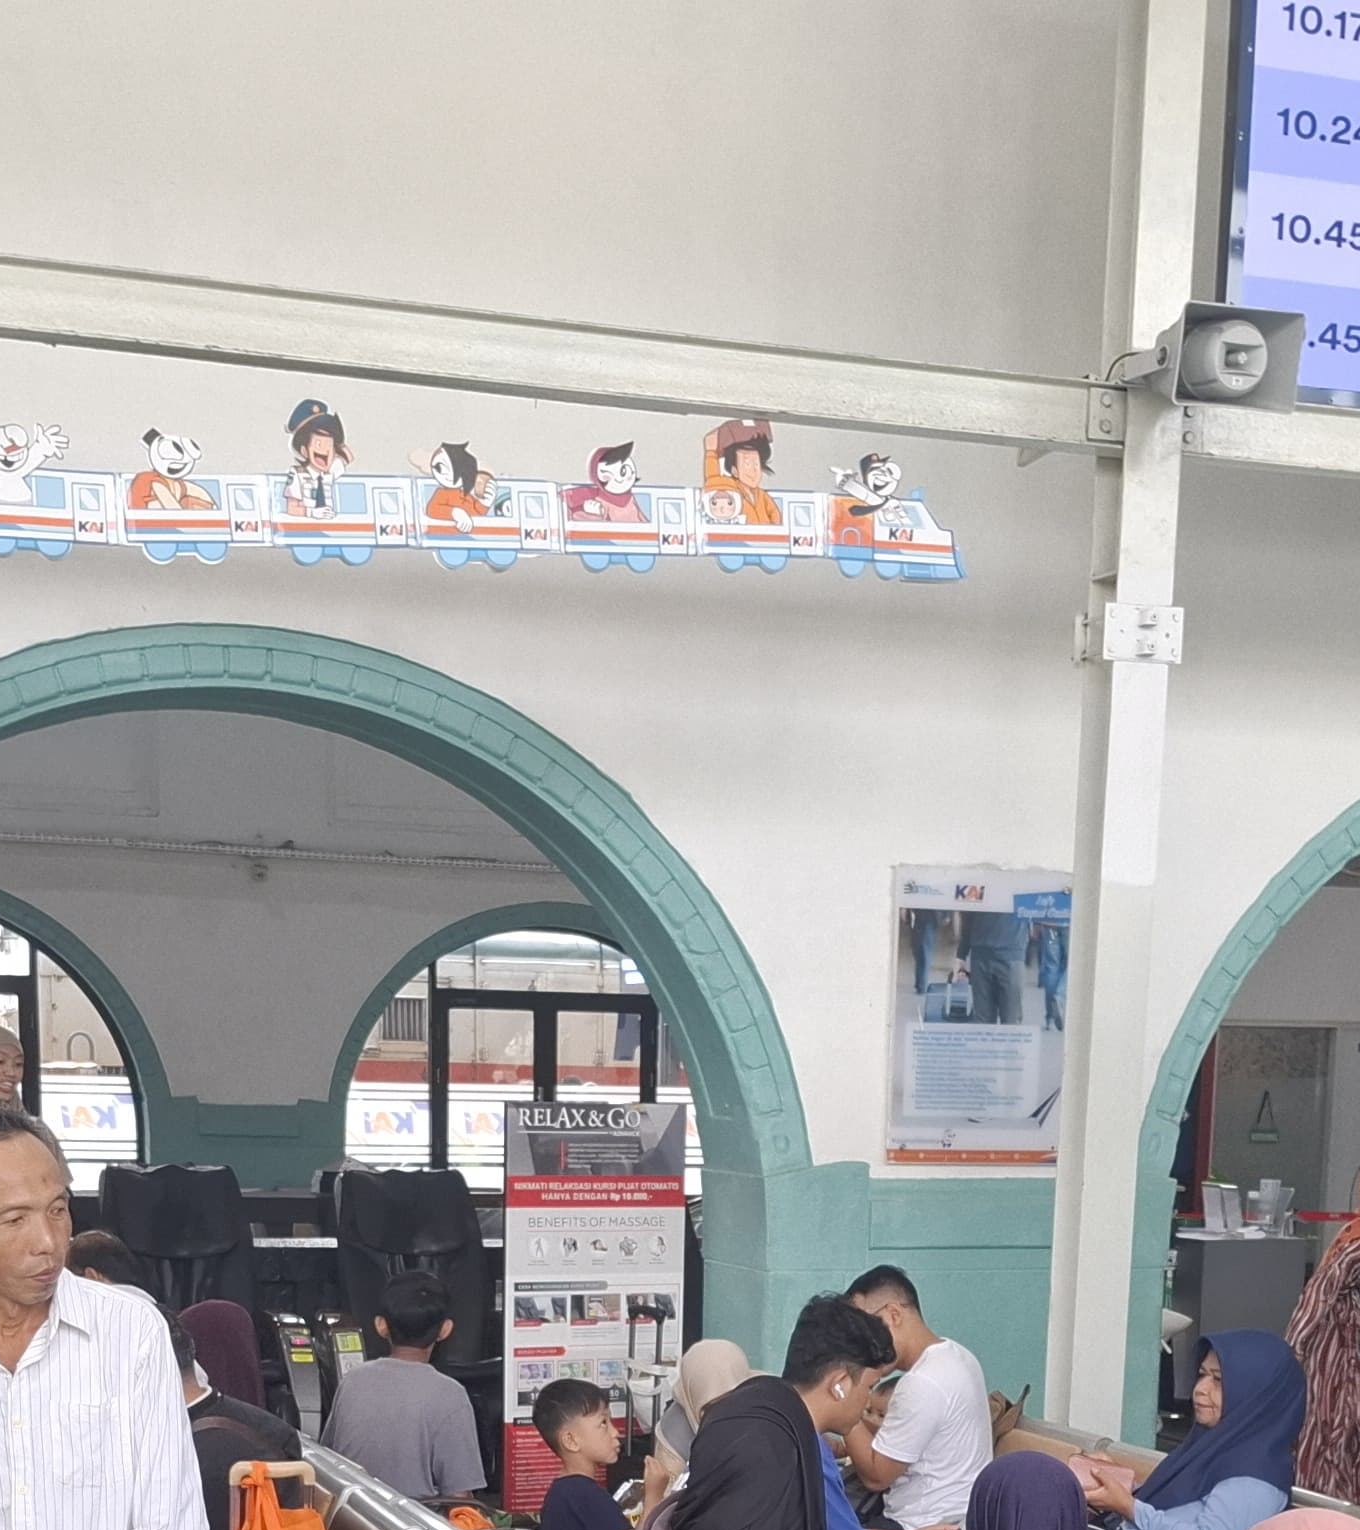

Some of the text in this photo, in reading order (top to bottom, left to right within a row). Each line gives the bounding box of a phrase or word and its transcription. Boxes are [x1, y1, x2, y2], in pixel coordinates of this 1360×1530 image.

[528, 1216, 666, 1229] BENEFITS OF MASSAGE
